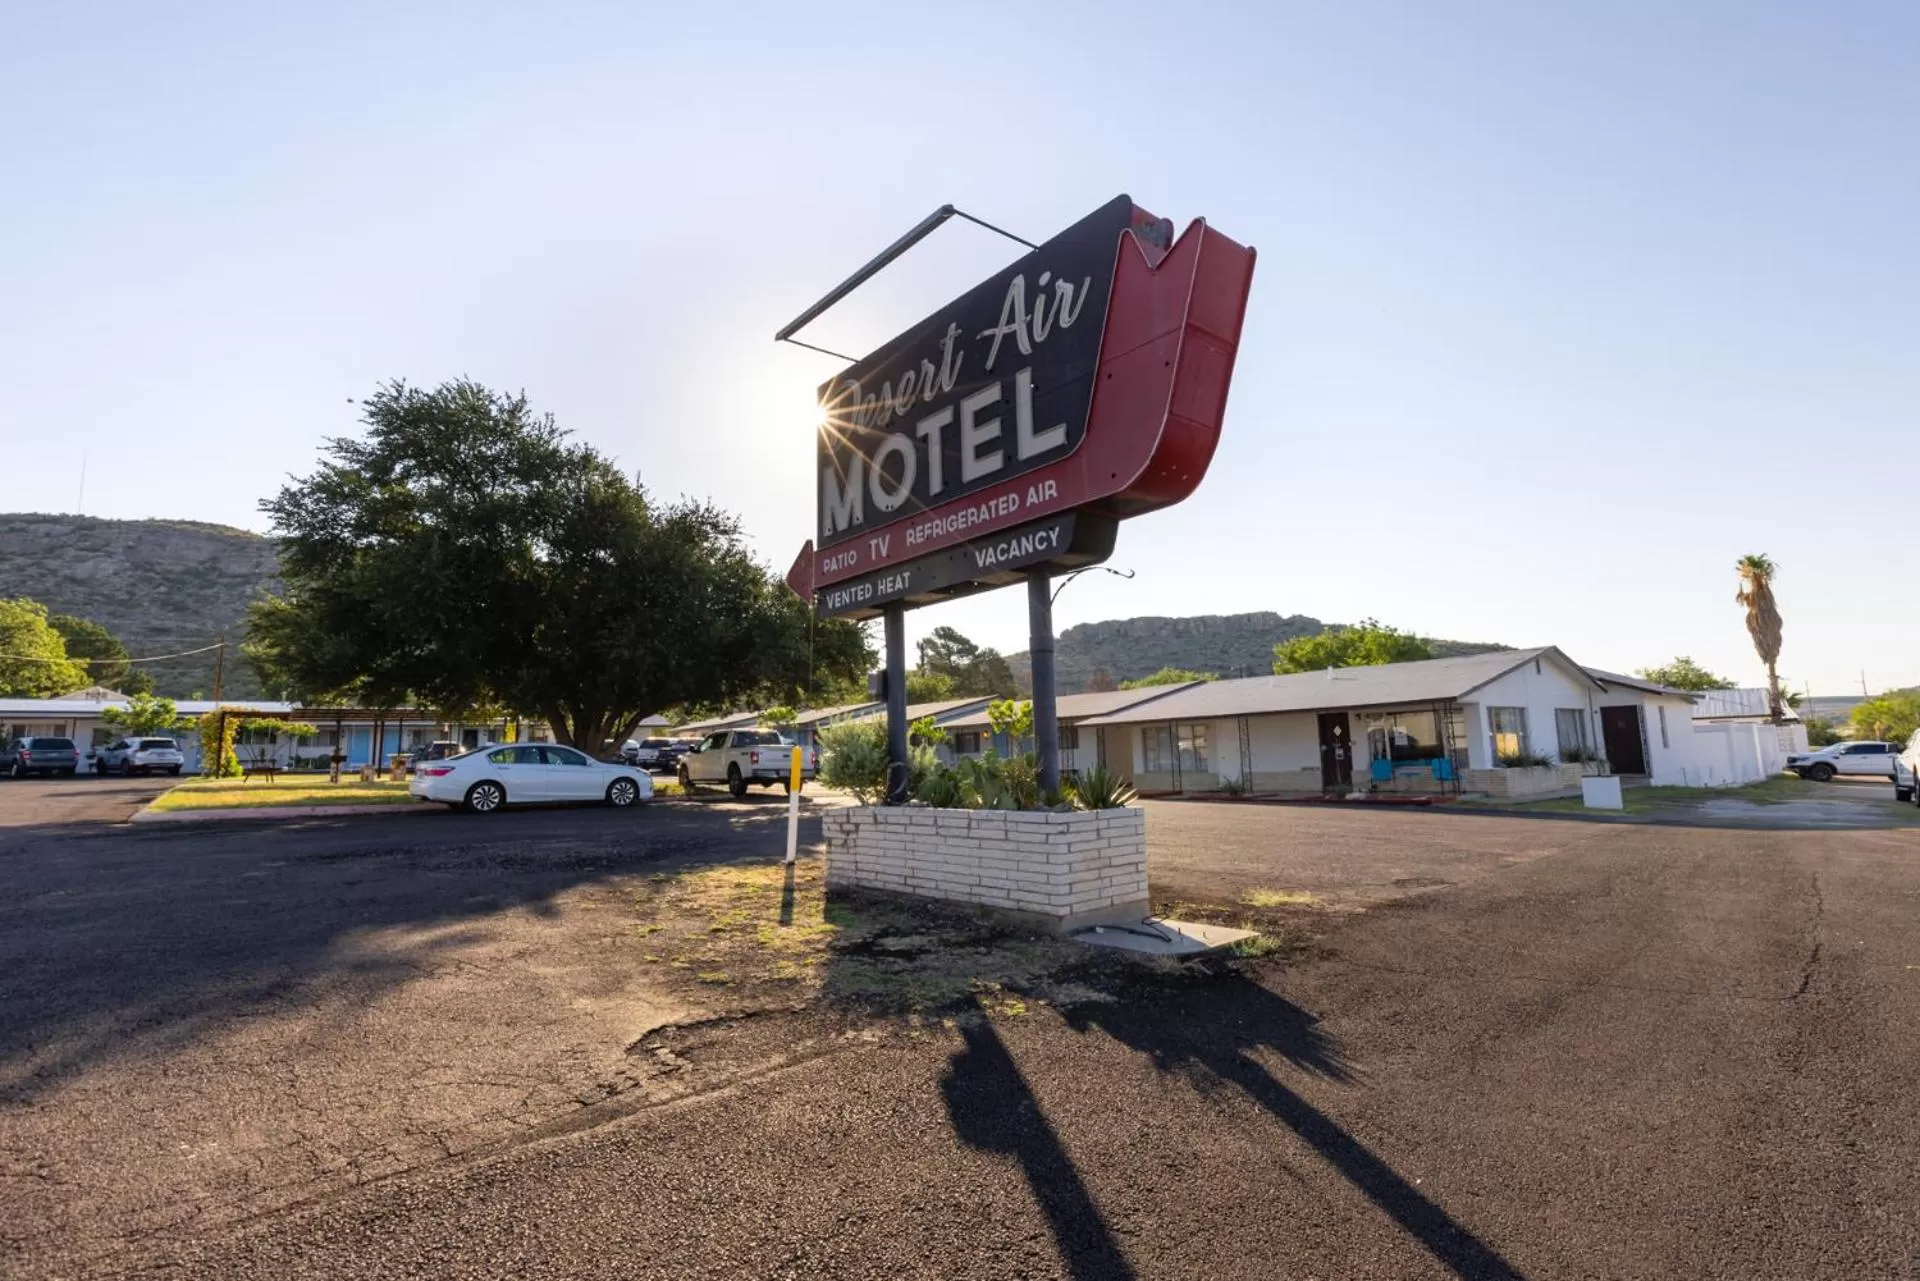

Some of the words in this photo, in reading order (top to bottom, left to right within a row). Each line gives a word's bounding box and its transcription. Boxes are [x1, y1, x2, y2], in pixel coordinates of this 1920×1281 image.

[824, 322, 964, 448] Desert
[977, 271, 1092, 370] Air
[823, 367, 1067, 536] MOTEL
[823, 552, 857, 574] PATIO
[869, 535, 890, 561] TV
[906, 497, 1020, 546] REFRIGERATED
[1026, 480, 1058, 507] AIR
[975, 527, 1060, 568] VACANCY
[826, 585, 872, 609] VENTED
[878, 572, 910, 596] HEAT
